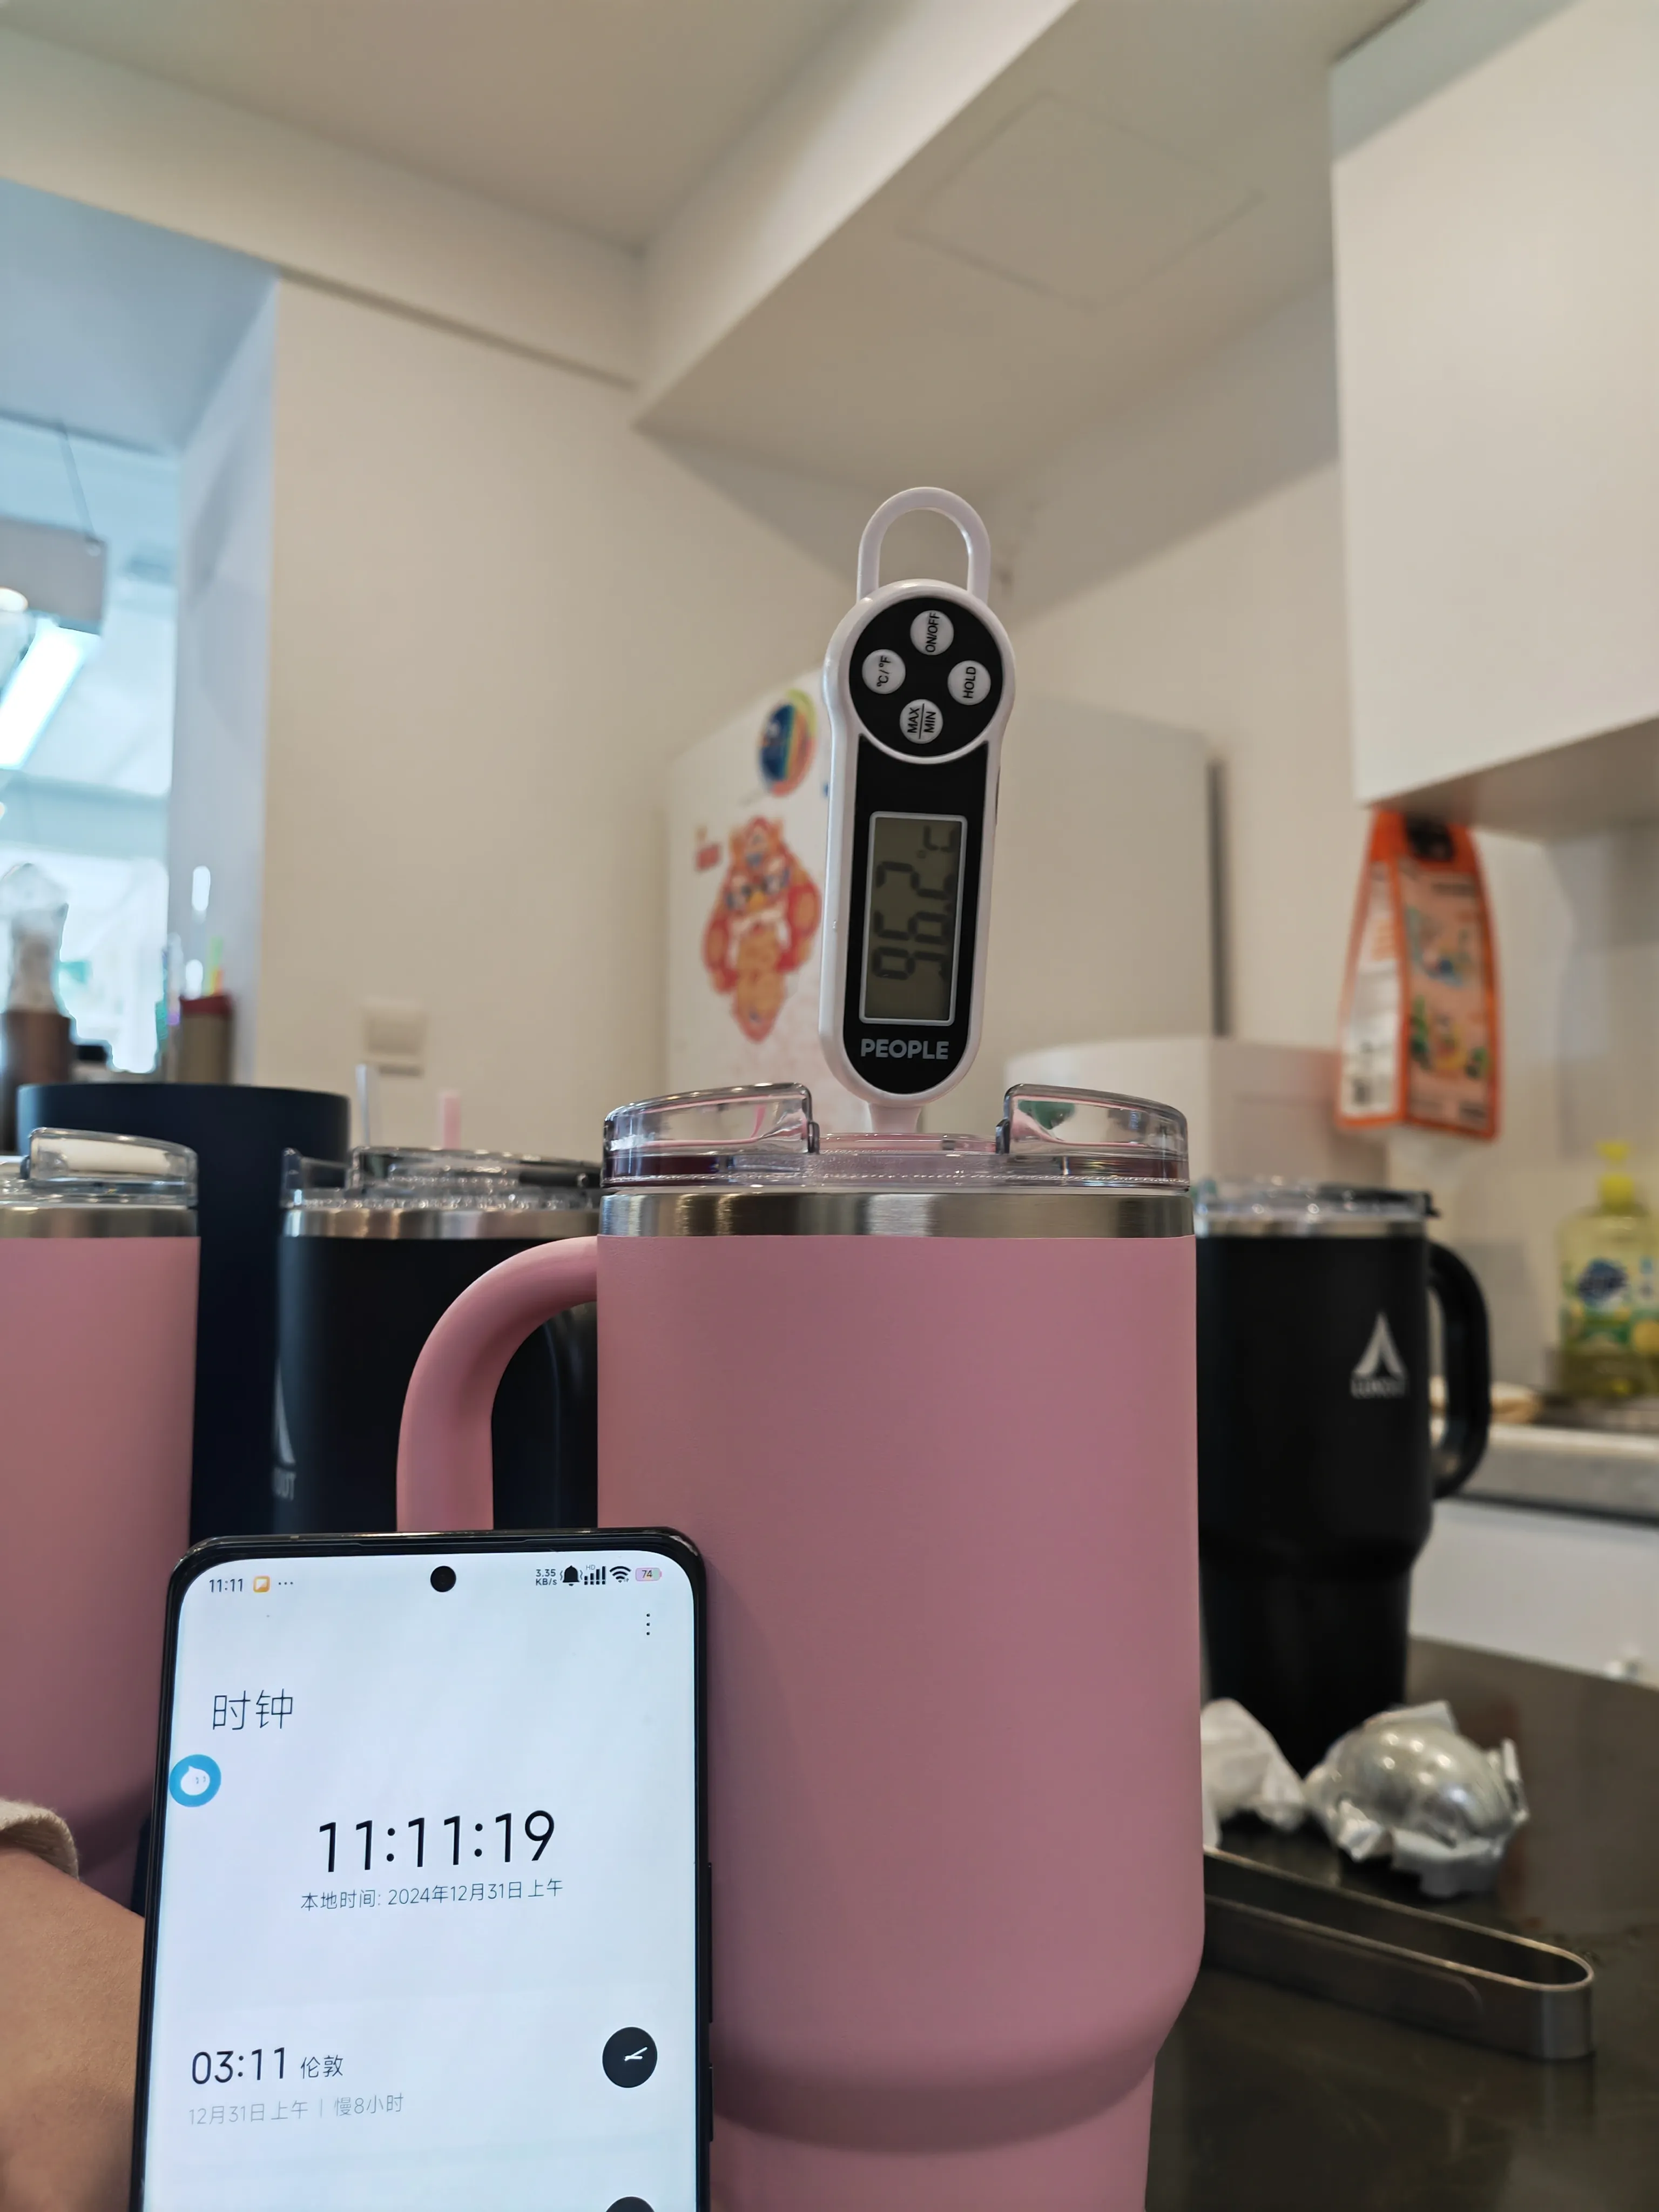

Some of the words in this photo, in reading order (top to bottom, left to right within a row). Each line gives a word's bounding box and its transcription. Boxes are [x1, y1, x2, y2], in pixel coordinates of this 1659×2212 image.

[925, 612, 940, 652] ON/OFF
[963, 666, 976, 698] HOLD
[907, 707, 920, 733] MAX
[924, 711, 936, 733] MIN
[861, 1038, 949, 1060] PEOPLE
[209, 1579, 244, 1593] 11:11
[642, 1570, 652, 1579] 74
[212, 1688, 294, 1730] 时钟
[319, 1810, 555, 1872] 11:11:19
[192, 2047, 285, 2085] 03:11
[300, 2054, 343, 2080] 伦敦
